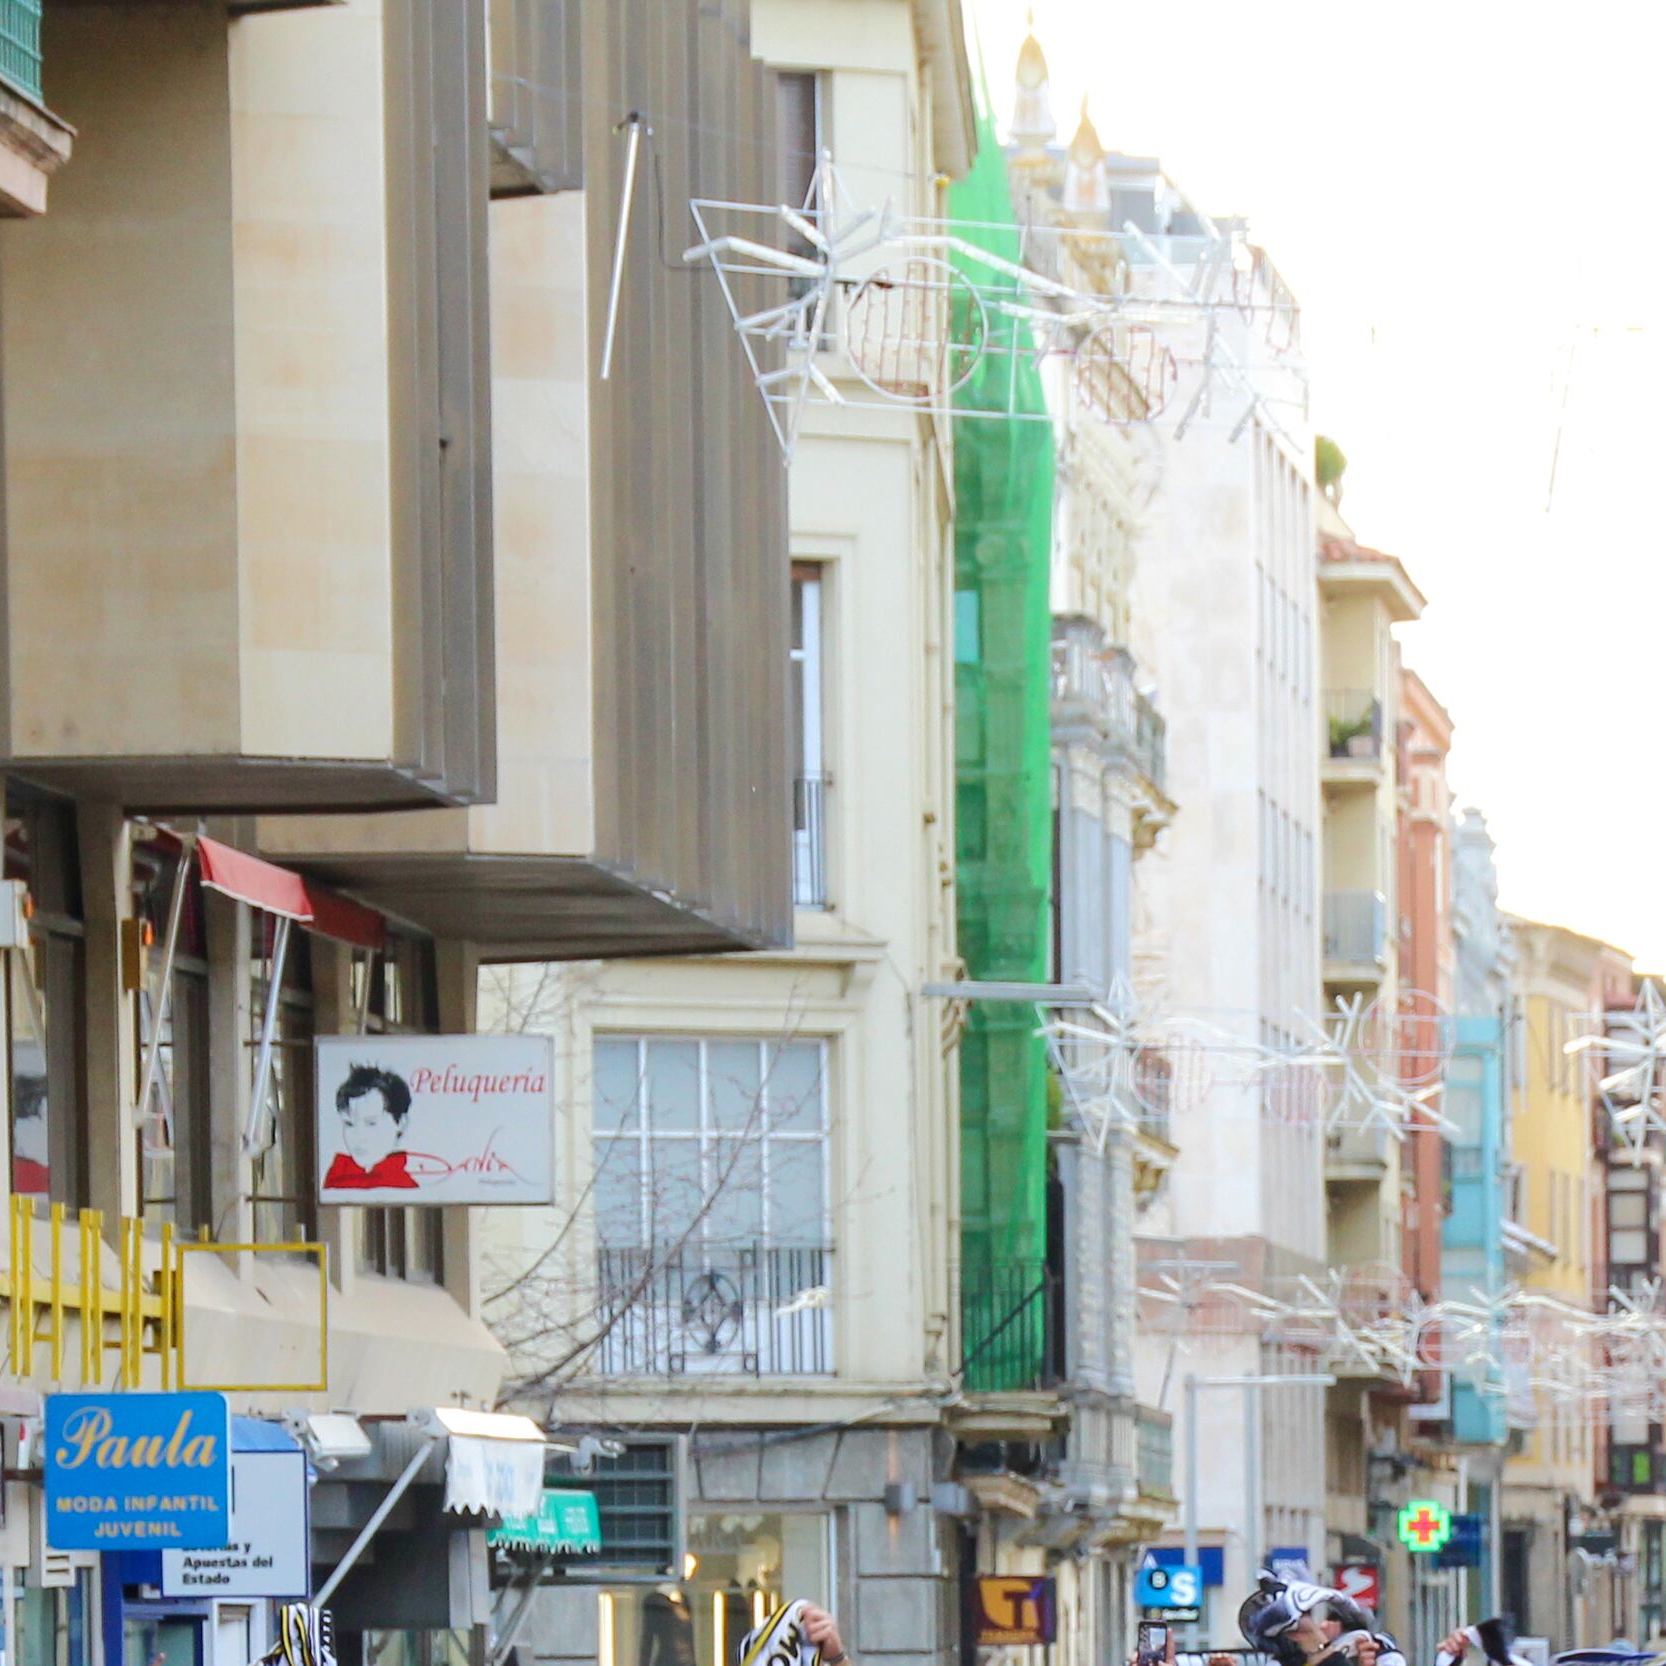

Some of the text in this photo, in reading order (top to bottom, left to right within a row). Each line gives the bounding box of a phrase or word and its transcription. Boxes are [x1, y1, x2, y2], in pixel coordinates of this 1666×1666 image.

[410, 1063, 546, 1104] Peluquería
[55, 1405, 218, 1470] Paula
[56, 1494, 220, 1513] MODA INFANTIL
[93, 1520, 183, 1537] JUVENIL
[183, 1556, 273, 1569] Apuestas del
[182, 1572, 231, 1585] Estado
